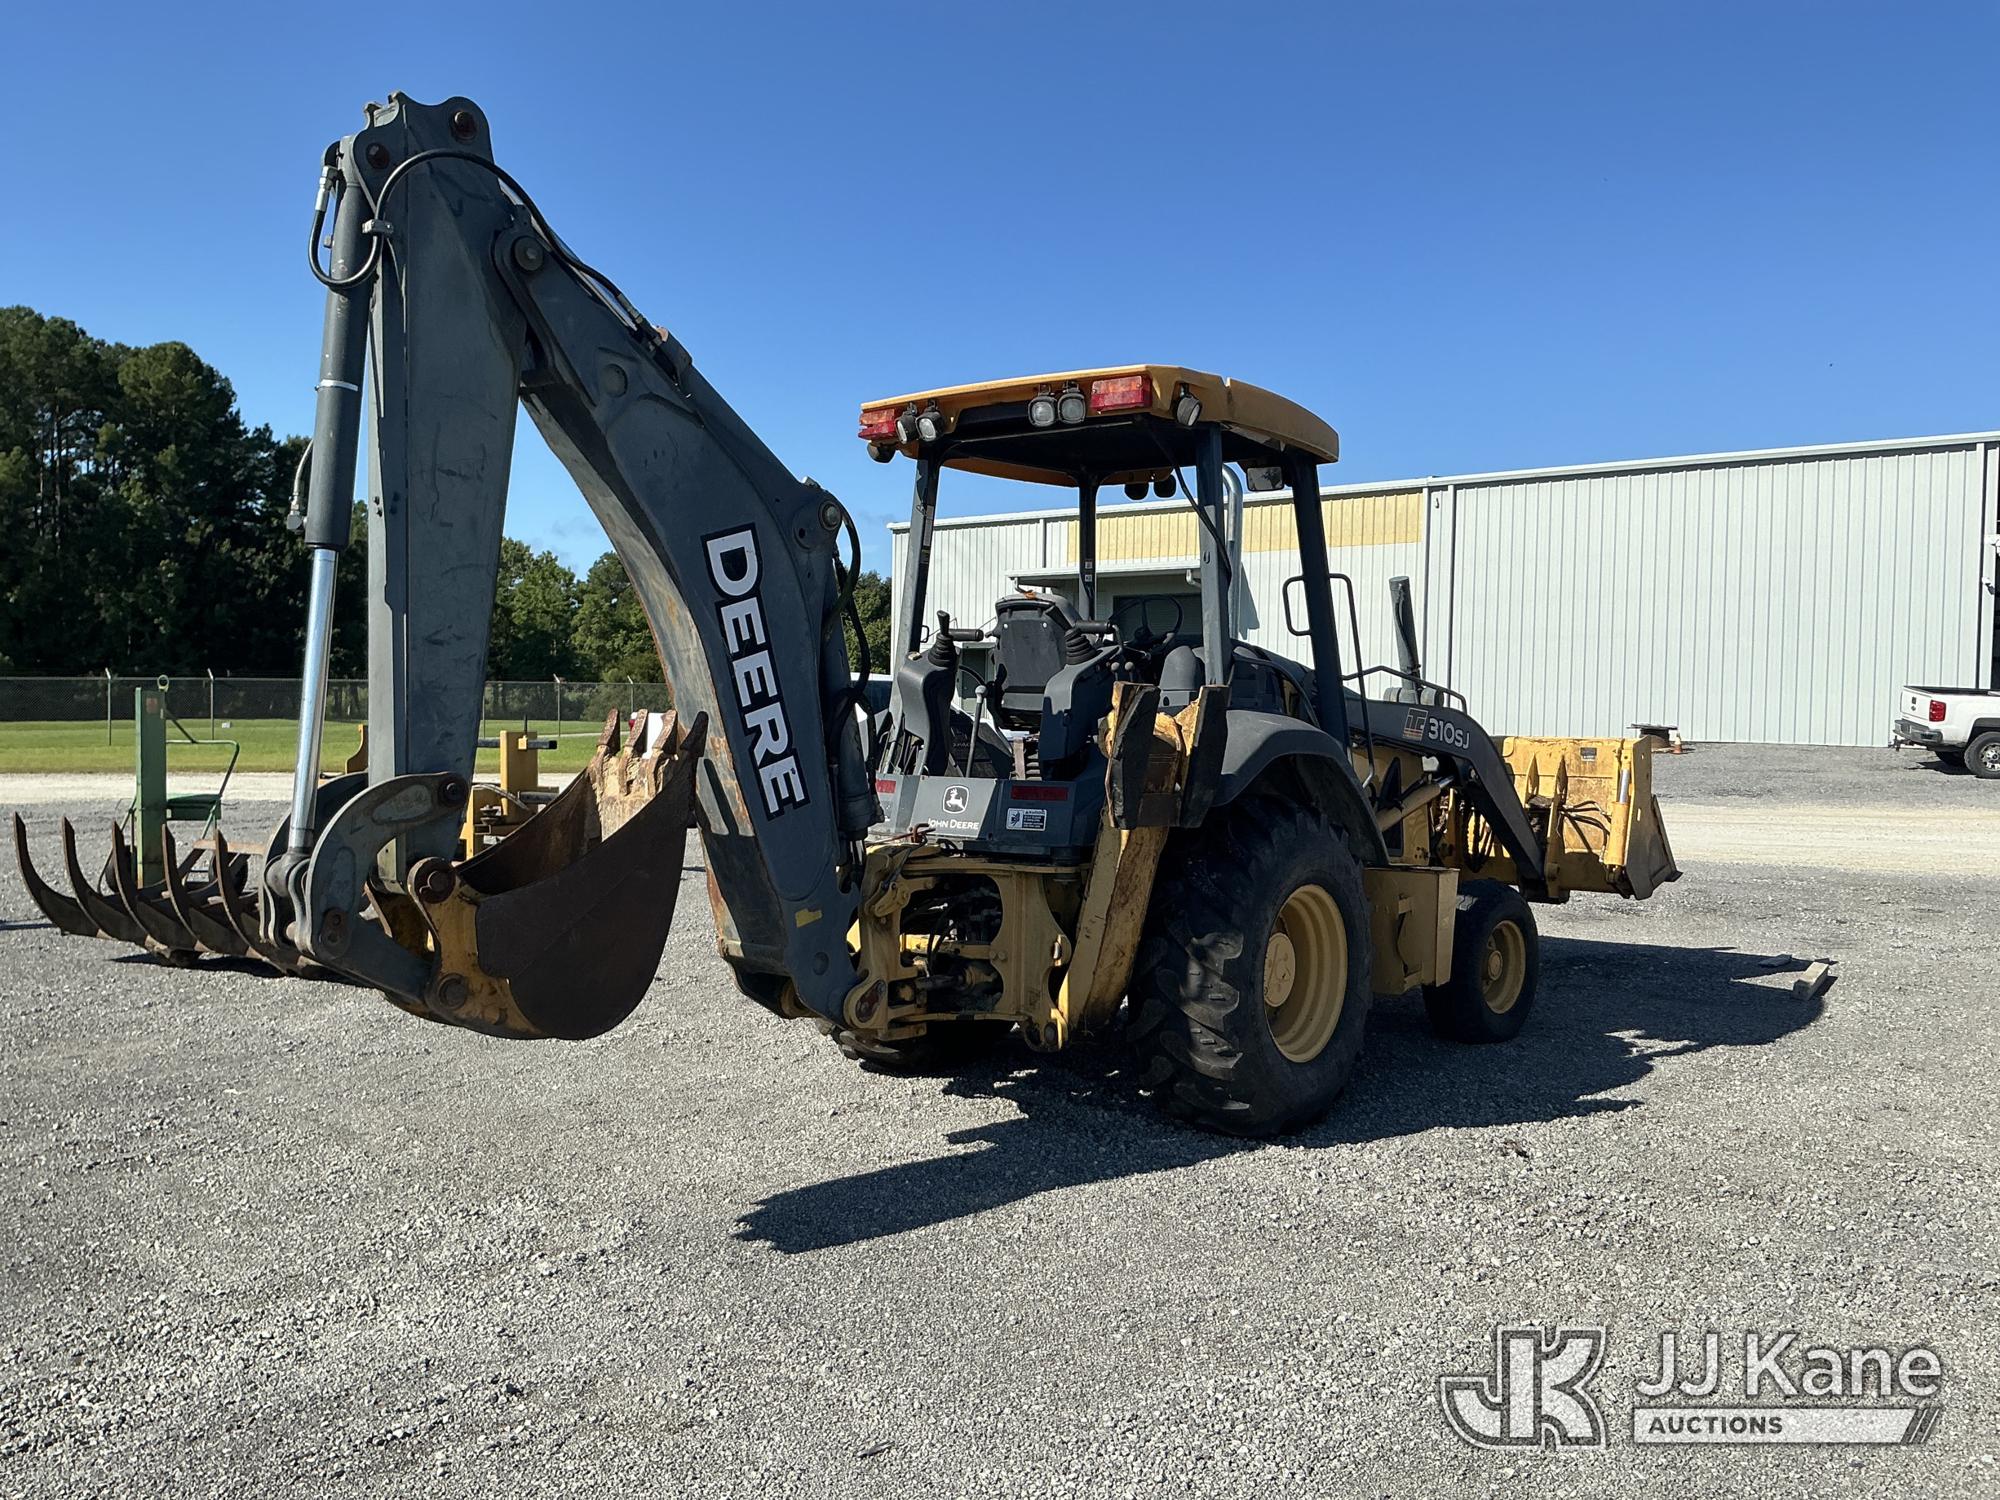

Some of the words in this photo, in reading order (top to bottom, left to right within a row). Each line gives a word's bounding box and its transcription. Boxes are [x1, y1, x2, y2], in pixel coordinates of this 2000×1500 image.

[704, 528, 806, 815] DEERE
[1428, 716, 1470, 749] 310SJ
[949, 818, 979, 830] DEERE
